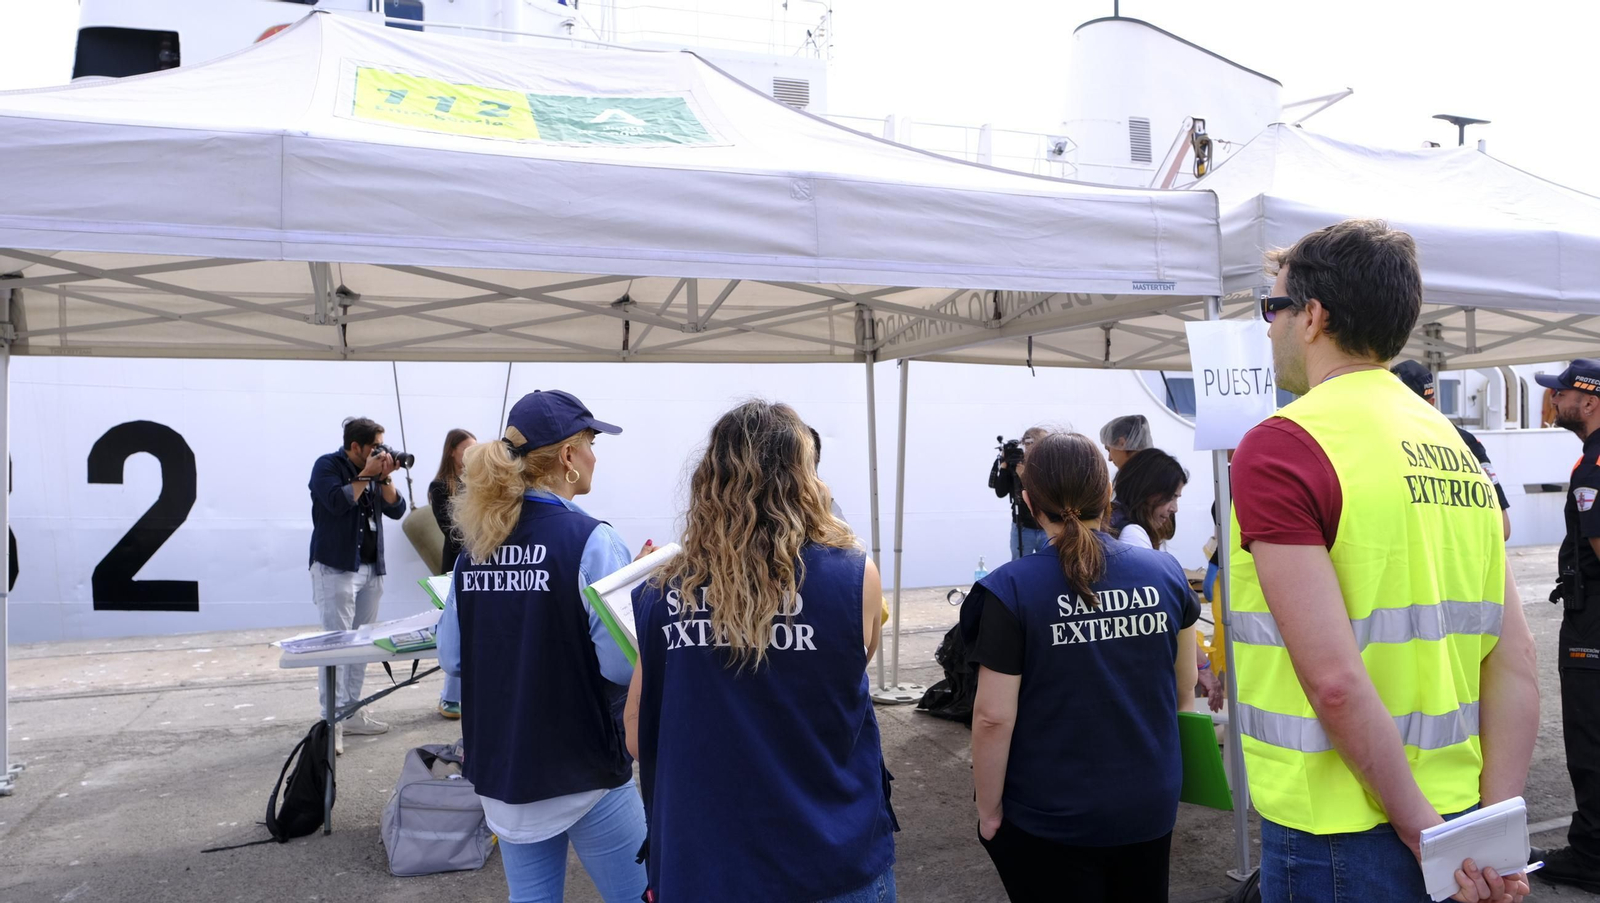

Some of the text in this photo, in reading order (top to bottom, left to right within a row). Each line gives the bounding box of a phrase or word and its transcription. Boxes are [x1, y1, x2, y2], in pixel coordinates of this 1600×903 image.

[377, 89, 512, 117] 112
[1132, 283, 1175, 291] MASTERTENT
[1204, 367, 1273, 397] PUESTA
[1575, 375, 1600, 387] PROTEC
[1403, 475, 1495, 509] EXTERIOR
[9, 420, 199, 612] 2
[470, 544, 547, 566] NIDAD
[461, 569, 550, 592] EXTERIOR
[1057, 586, 1160, 617] SANIDAD
[661, 619, 818, 651] EXTEOR
[1050, 611, 1168, 646] EXTERIOR
